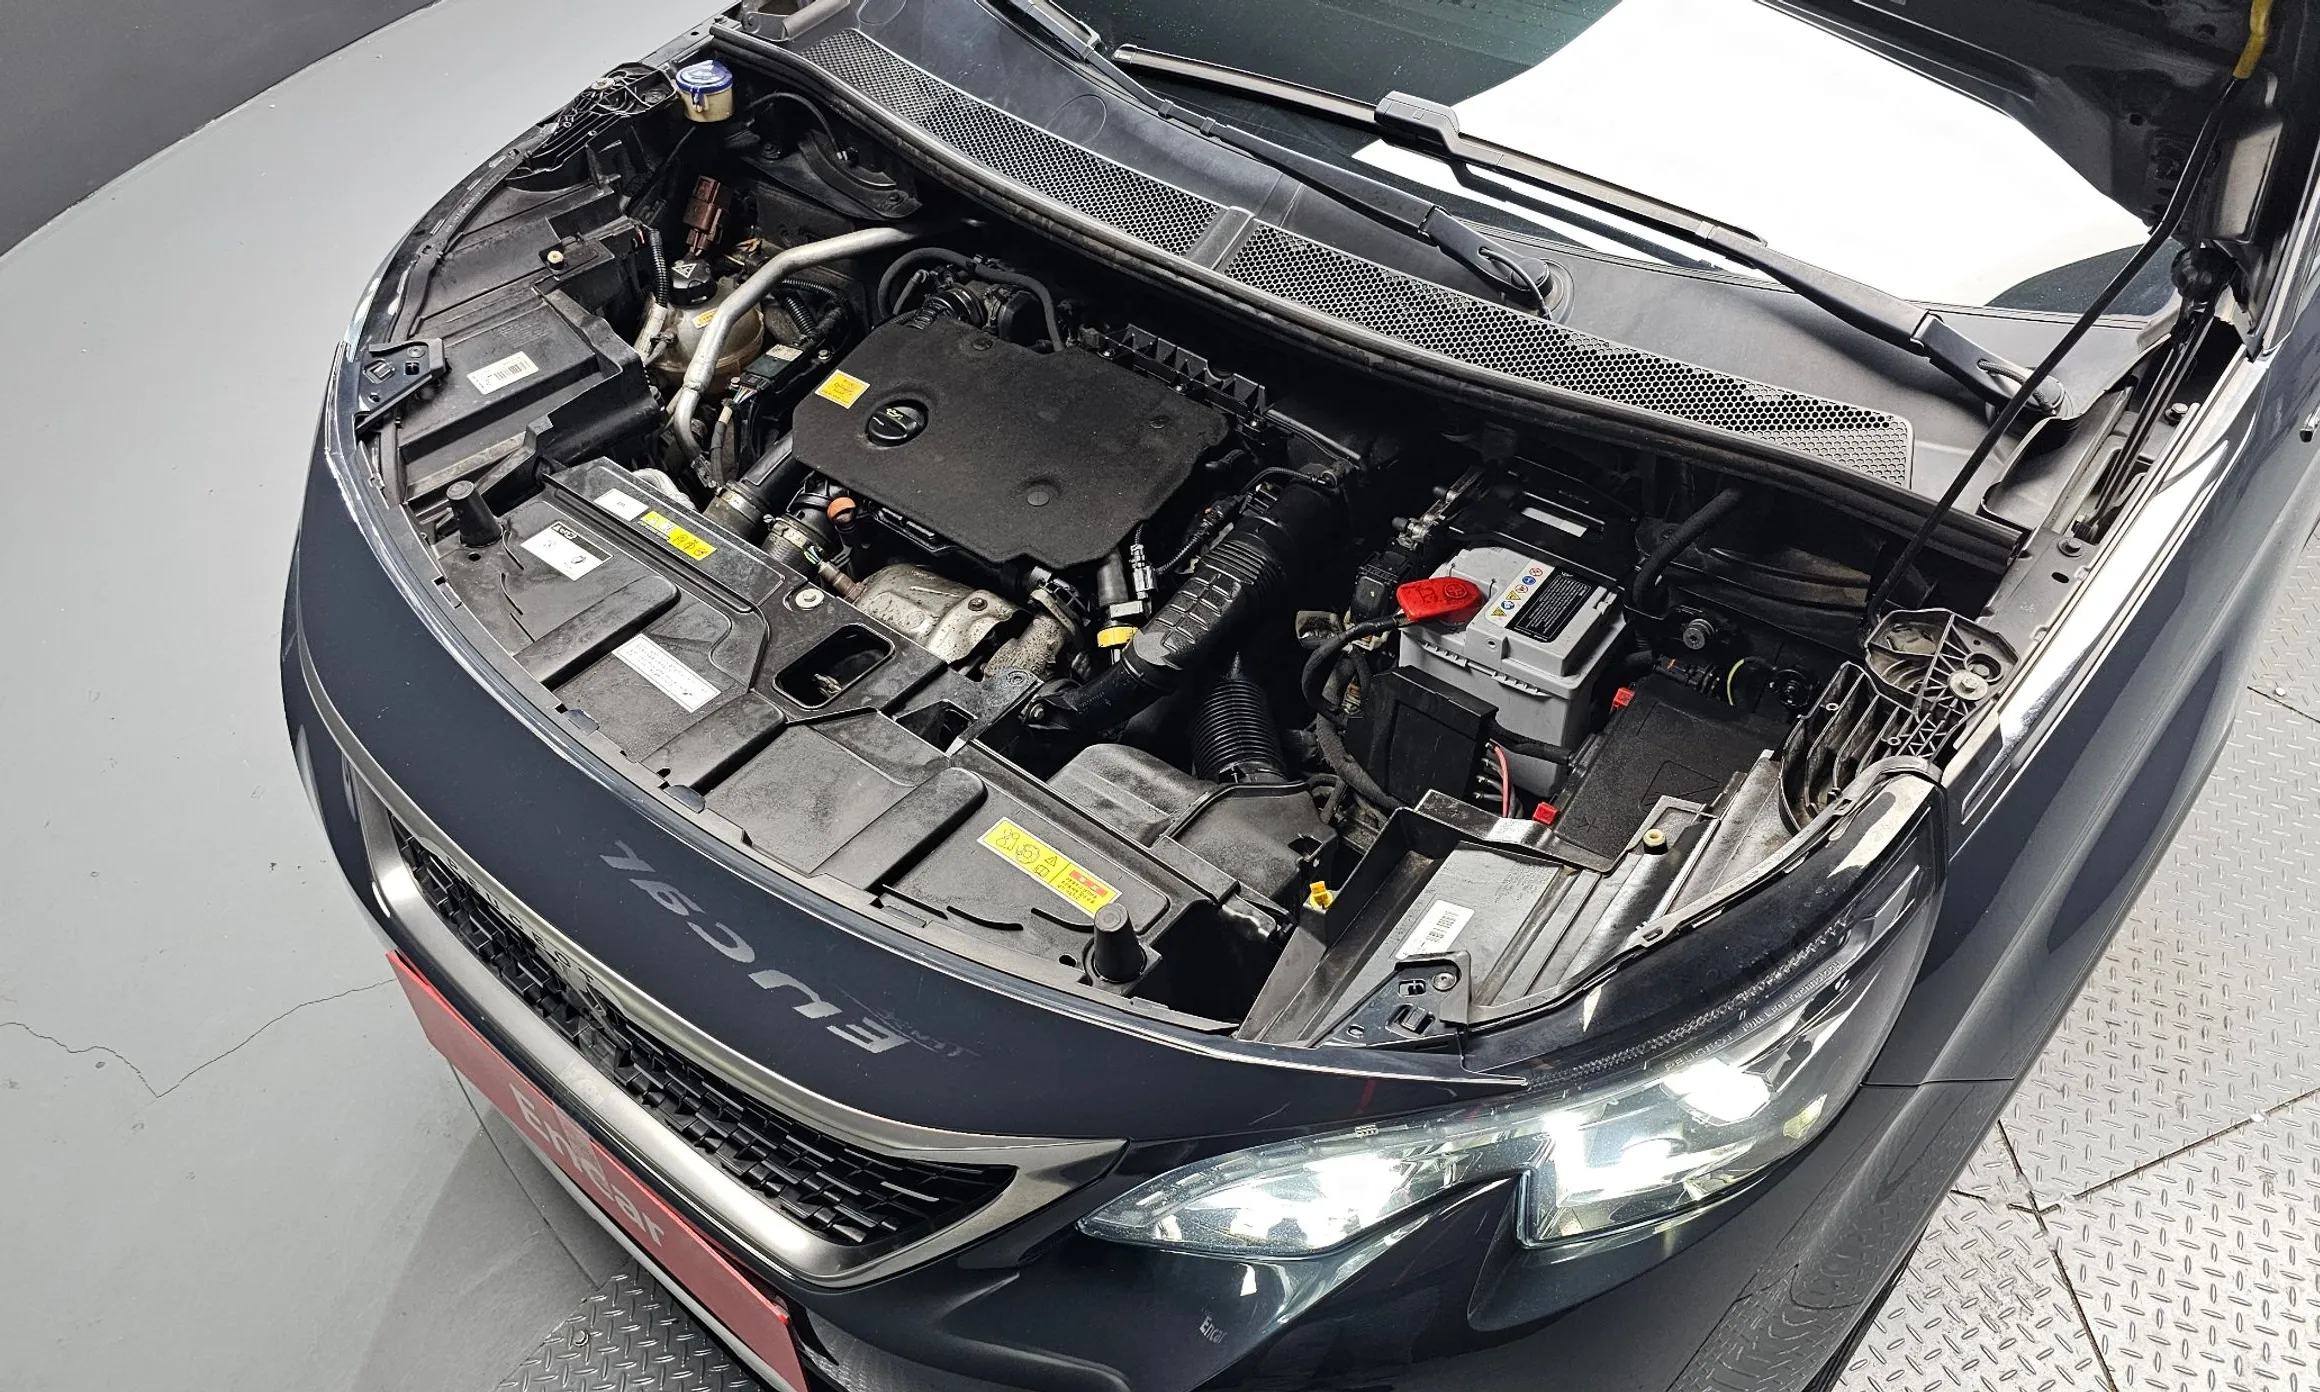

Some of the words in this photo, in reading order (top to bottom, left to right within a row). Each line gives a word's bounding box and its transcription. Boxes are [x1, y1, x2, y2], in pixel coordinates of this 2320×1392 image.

[446, 855, 595, 984] PEUGEOT
[508, 1082, 665, 1248] Encar
[1199, 1315, 1228, 1344] Encar
